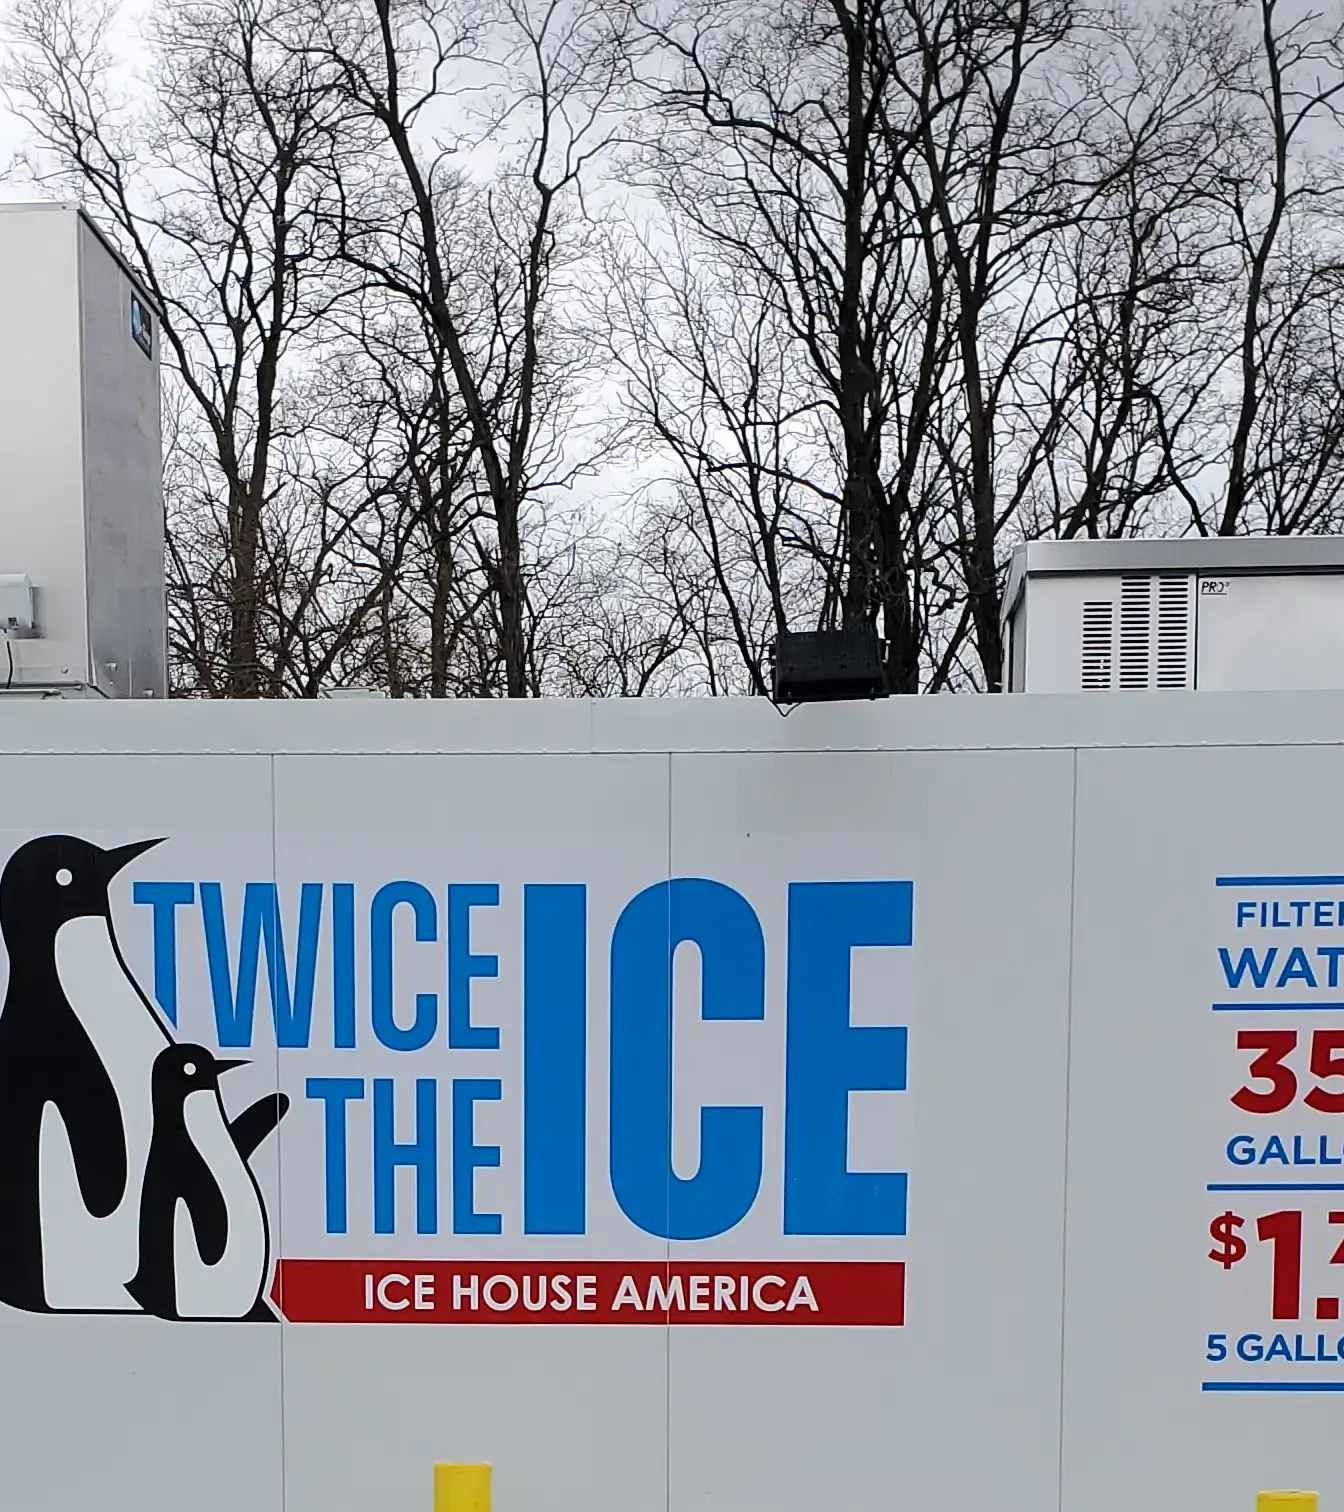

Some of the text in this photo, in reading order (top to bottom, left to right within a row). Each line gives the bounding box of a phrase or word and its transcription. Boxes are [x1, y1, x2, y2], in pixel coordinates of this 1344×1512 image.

[132, 880, 501, 1052] TWICE
[522, 877, 914, 1241] ICE
[305, 1076, 503, 1236] THE
[364, 1273, 820, 1313] ICE HOUSE AMERICA
[1205, 1333, 1229, 1363] 5
